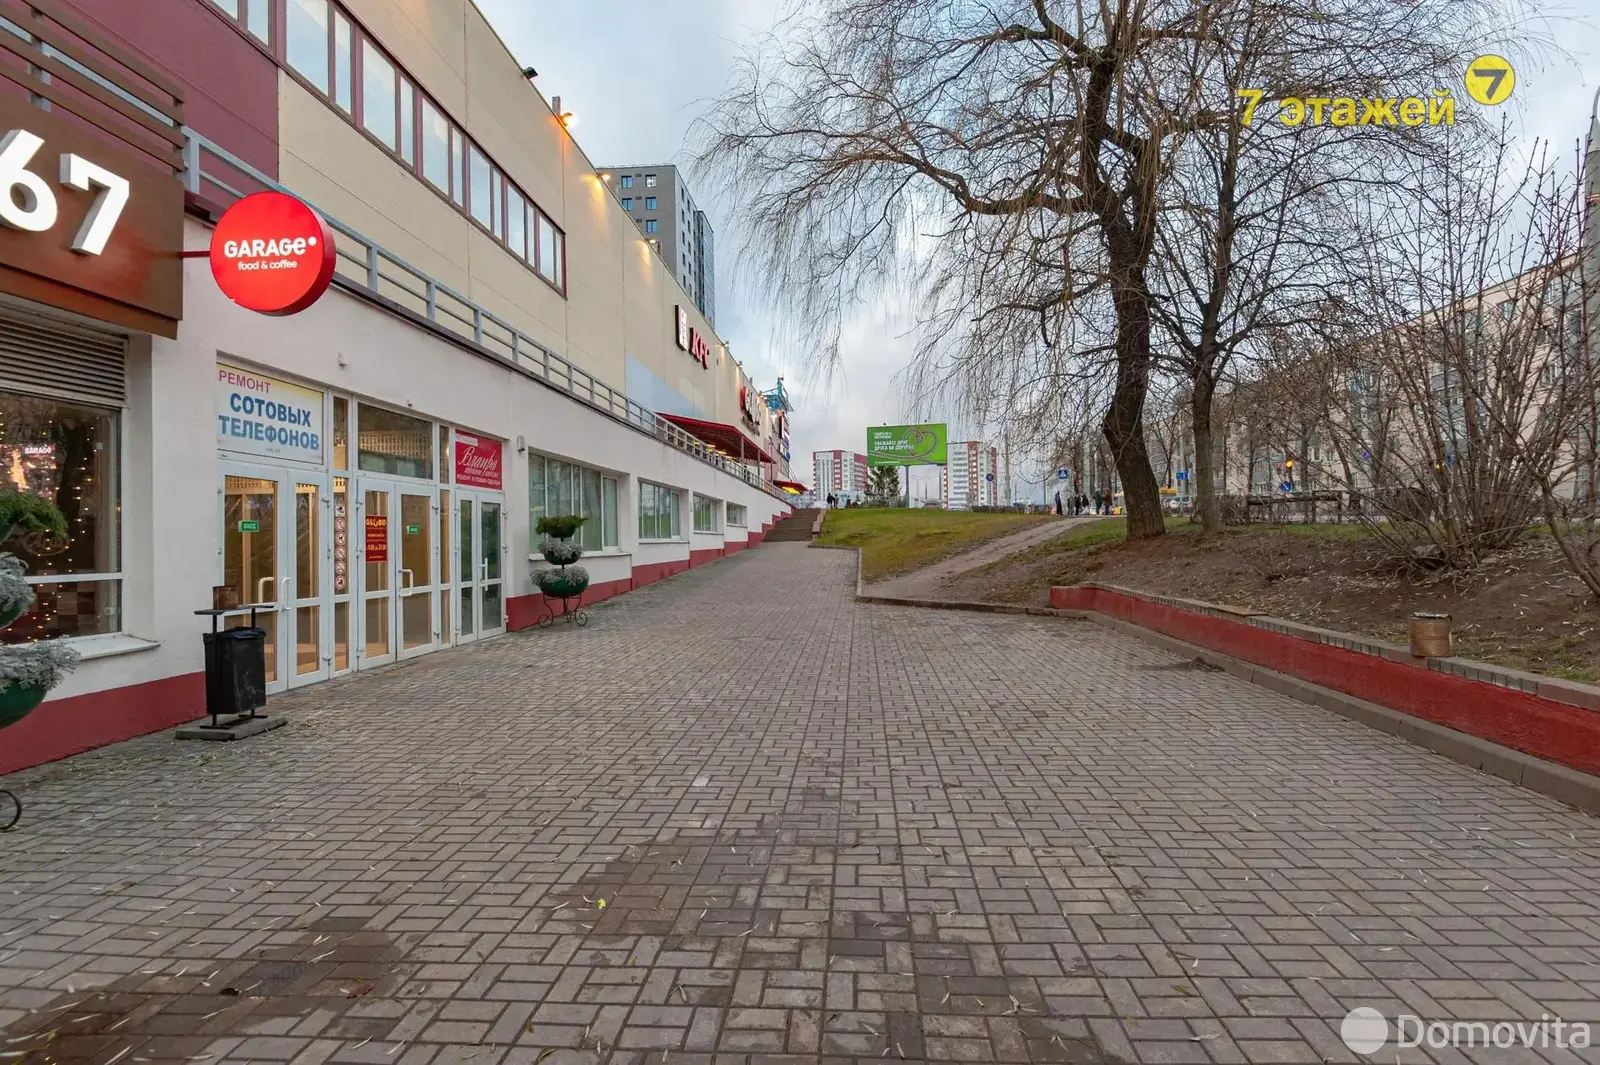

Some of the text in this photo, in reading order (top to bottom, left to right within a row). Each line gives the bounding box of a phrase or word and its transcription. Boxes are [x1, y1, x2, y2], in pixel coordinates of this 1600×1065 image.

[238, 258, 298, 271] food & coffee
[690, 327, 711, 370] KFC
[219, 369, 271, 394] РЕМОНТ
[230, 392, 311, 427] СОТОВЫХ
[218, 414, 320, 451] ТЕЛЕФОНОВ
